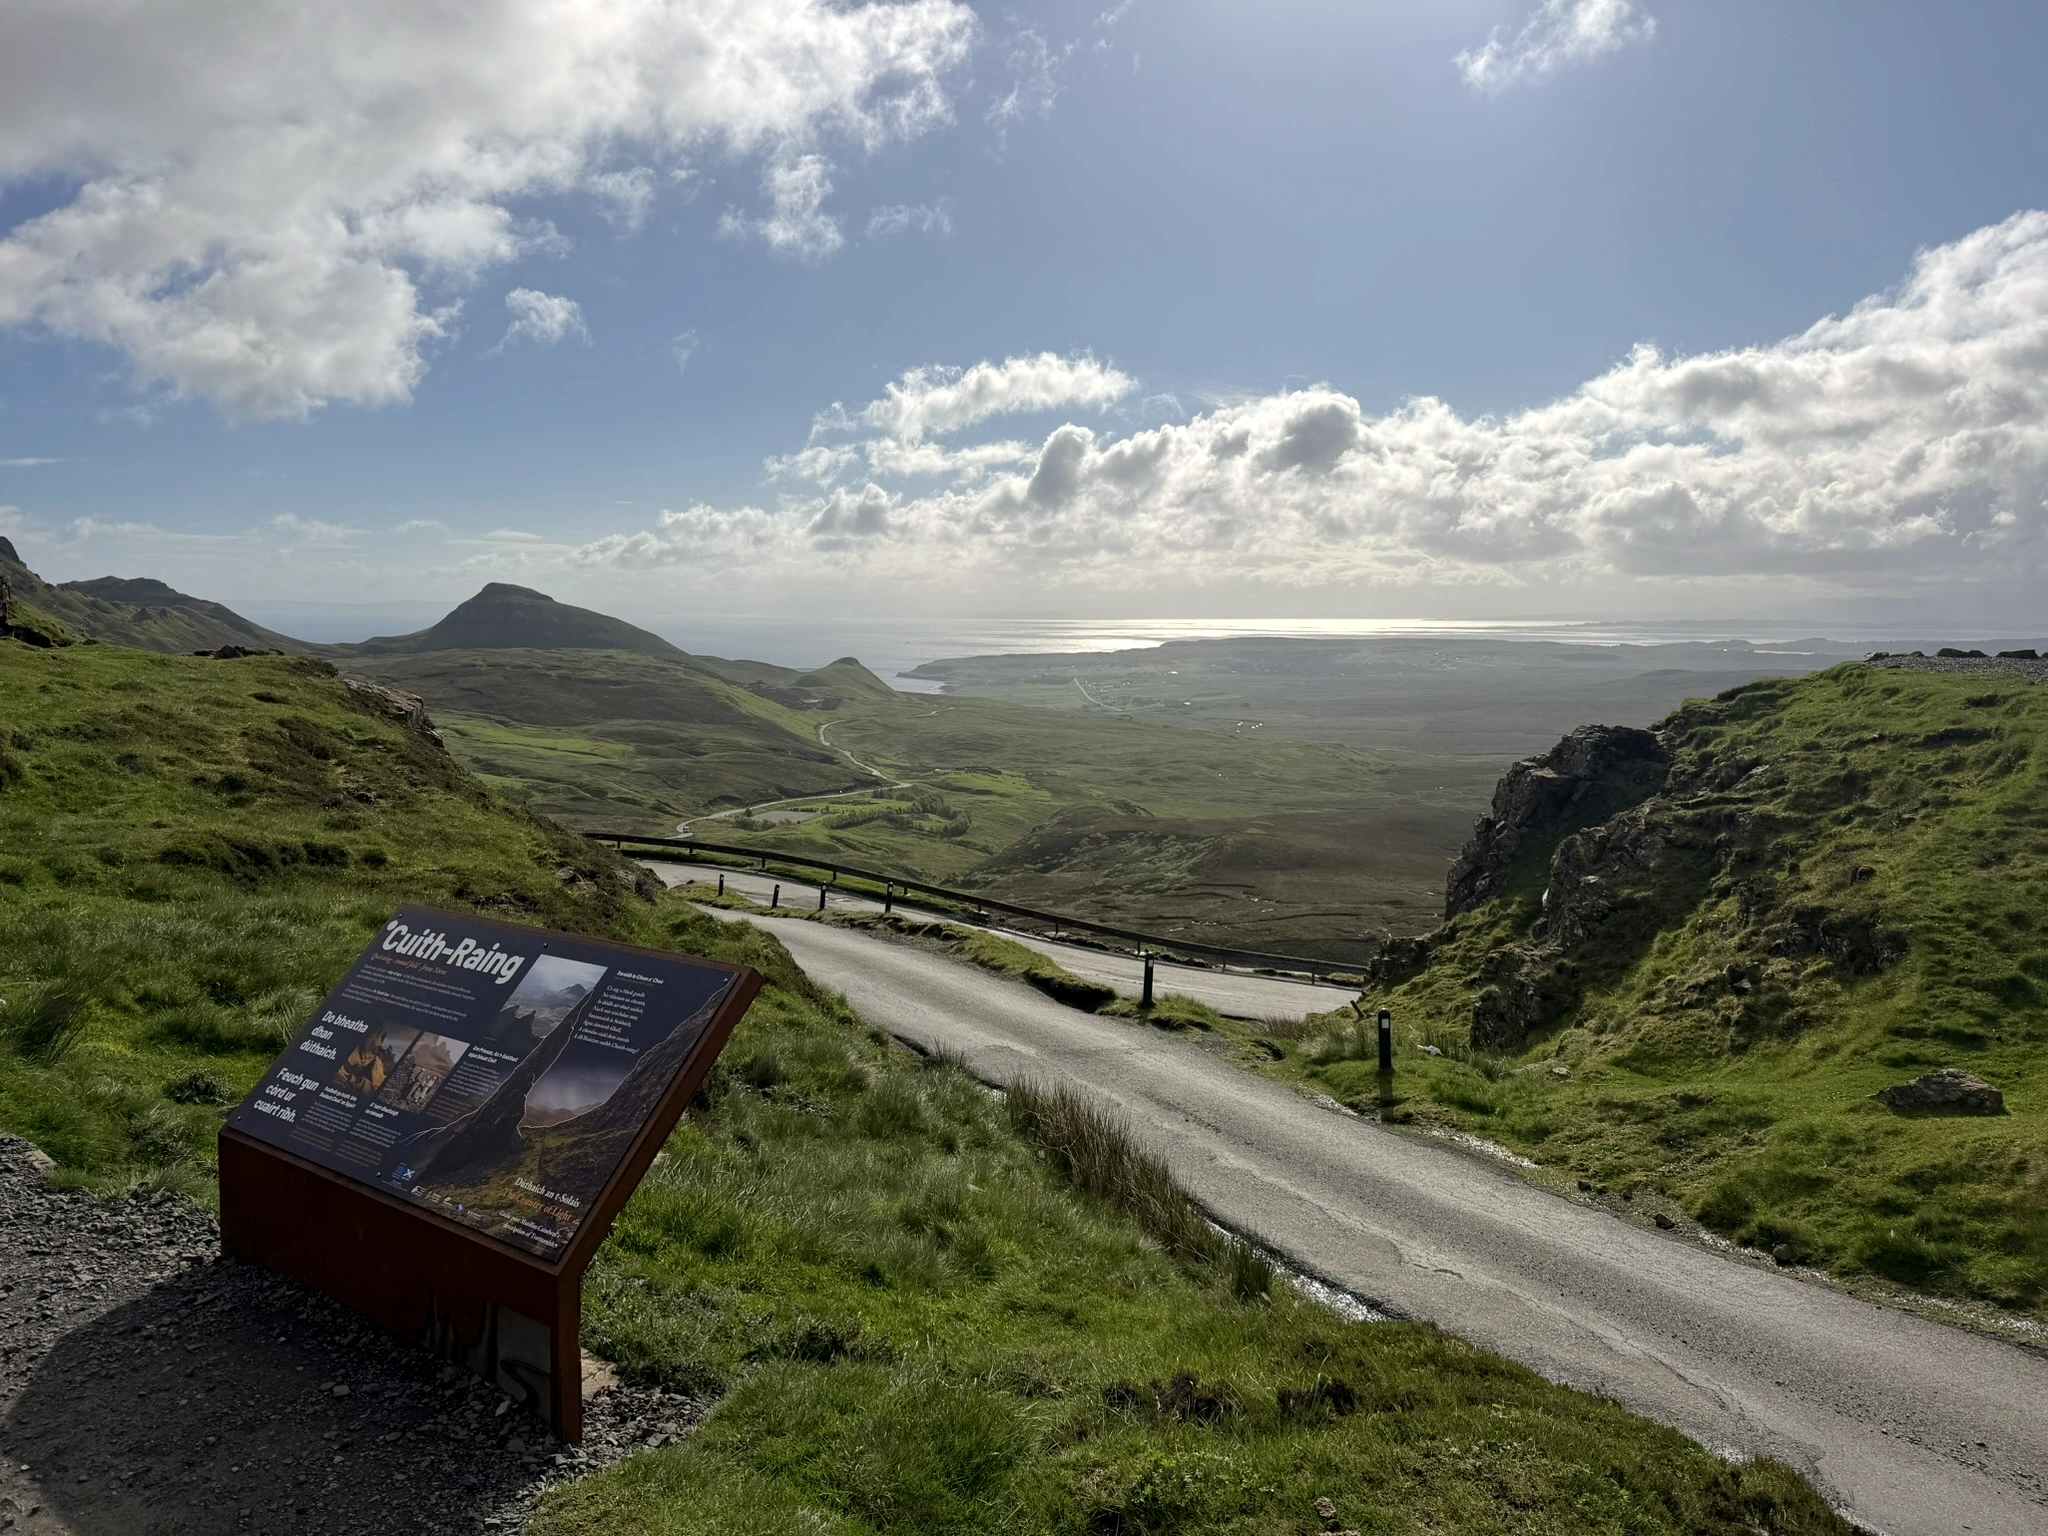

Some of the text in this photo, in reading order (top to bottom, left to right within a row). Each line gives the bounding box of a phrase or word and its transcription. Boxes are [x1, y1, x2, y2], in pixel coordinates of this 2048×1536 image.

[322, 1011, 368, 1032] Do bheatha
[311, 1026, 333, 1040] dhan
[277, 1068, 319, 1091] Feuch gun
[266, 1084, 296, 1101] còrd ur
[254, 1100, 280, 1115] cuairt
[276, 1107, 295, 1122] ribh.
[516, 1193, 544, 1212] Country
[544, 1205, 553, 1213] of
[551, 1206, 572, 1222] Light
[545, 1188, 554, 1198] an
[554, 1193, 580, 1208] t-Solais
